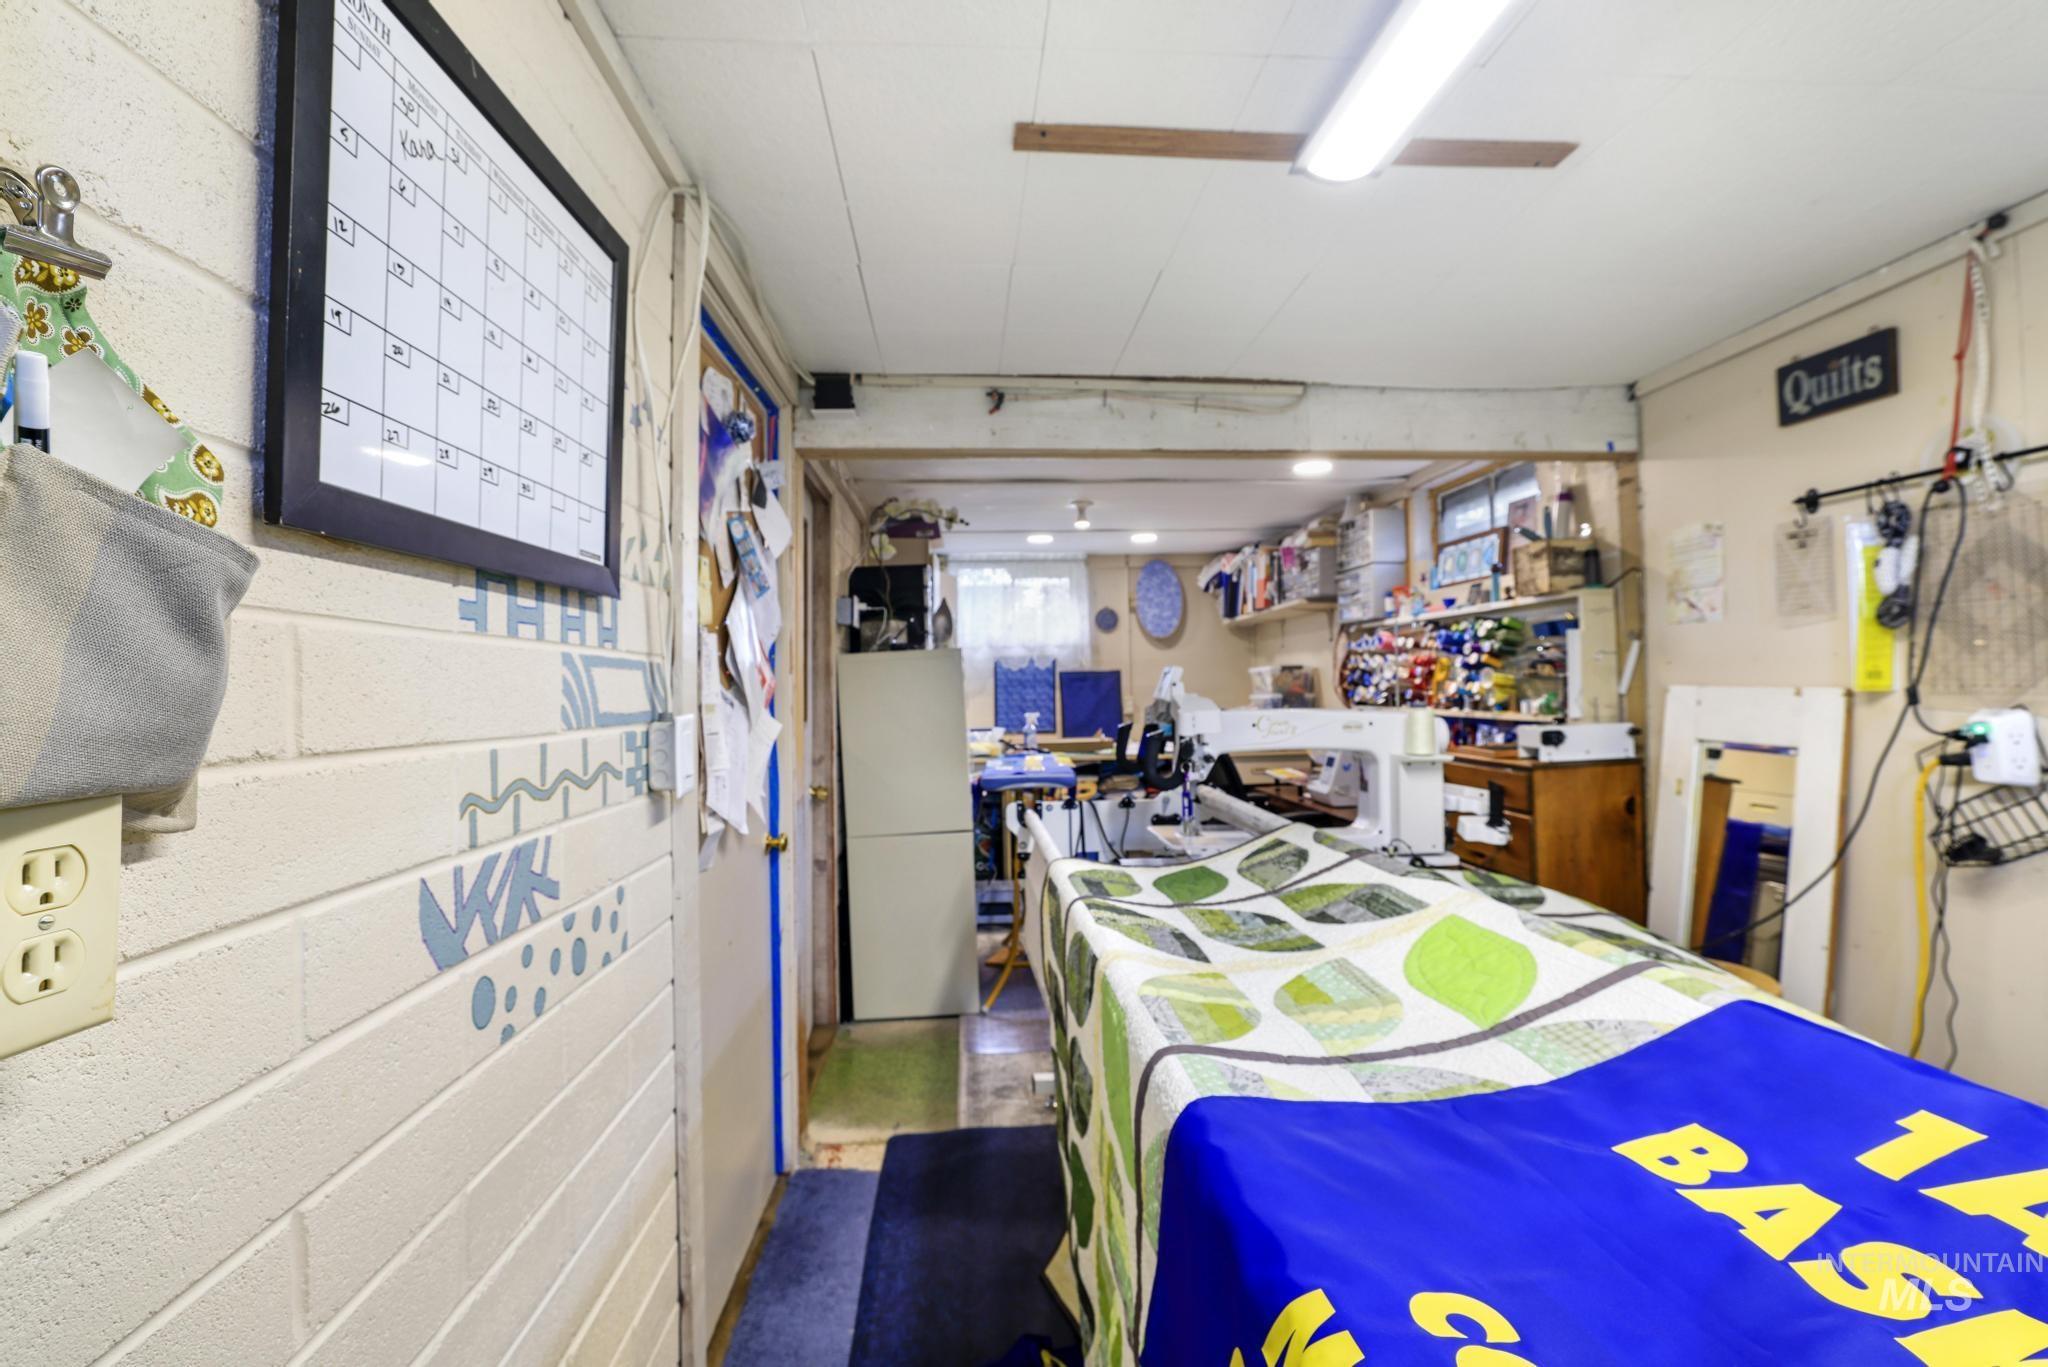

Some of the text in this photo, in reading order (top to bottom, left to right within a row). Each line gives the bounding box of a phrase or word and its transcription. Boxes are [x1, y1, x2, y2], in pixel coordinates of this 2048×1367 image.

[341, 0, 391, 46] ONTH
[340, 127, 348, 142] 5
[333, 216, 348, 233] 12
[330, 307, 342, 327] 19
[1782, 354, 1884, 416] Quilts
[320, 401, 341, 415] 26
[386, 428, 400, 443] 27
[439, 448, 450, 460] 28
